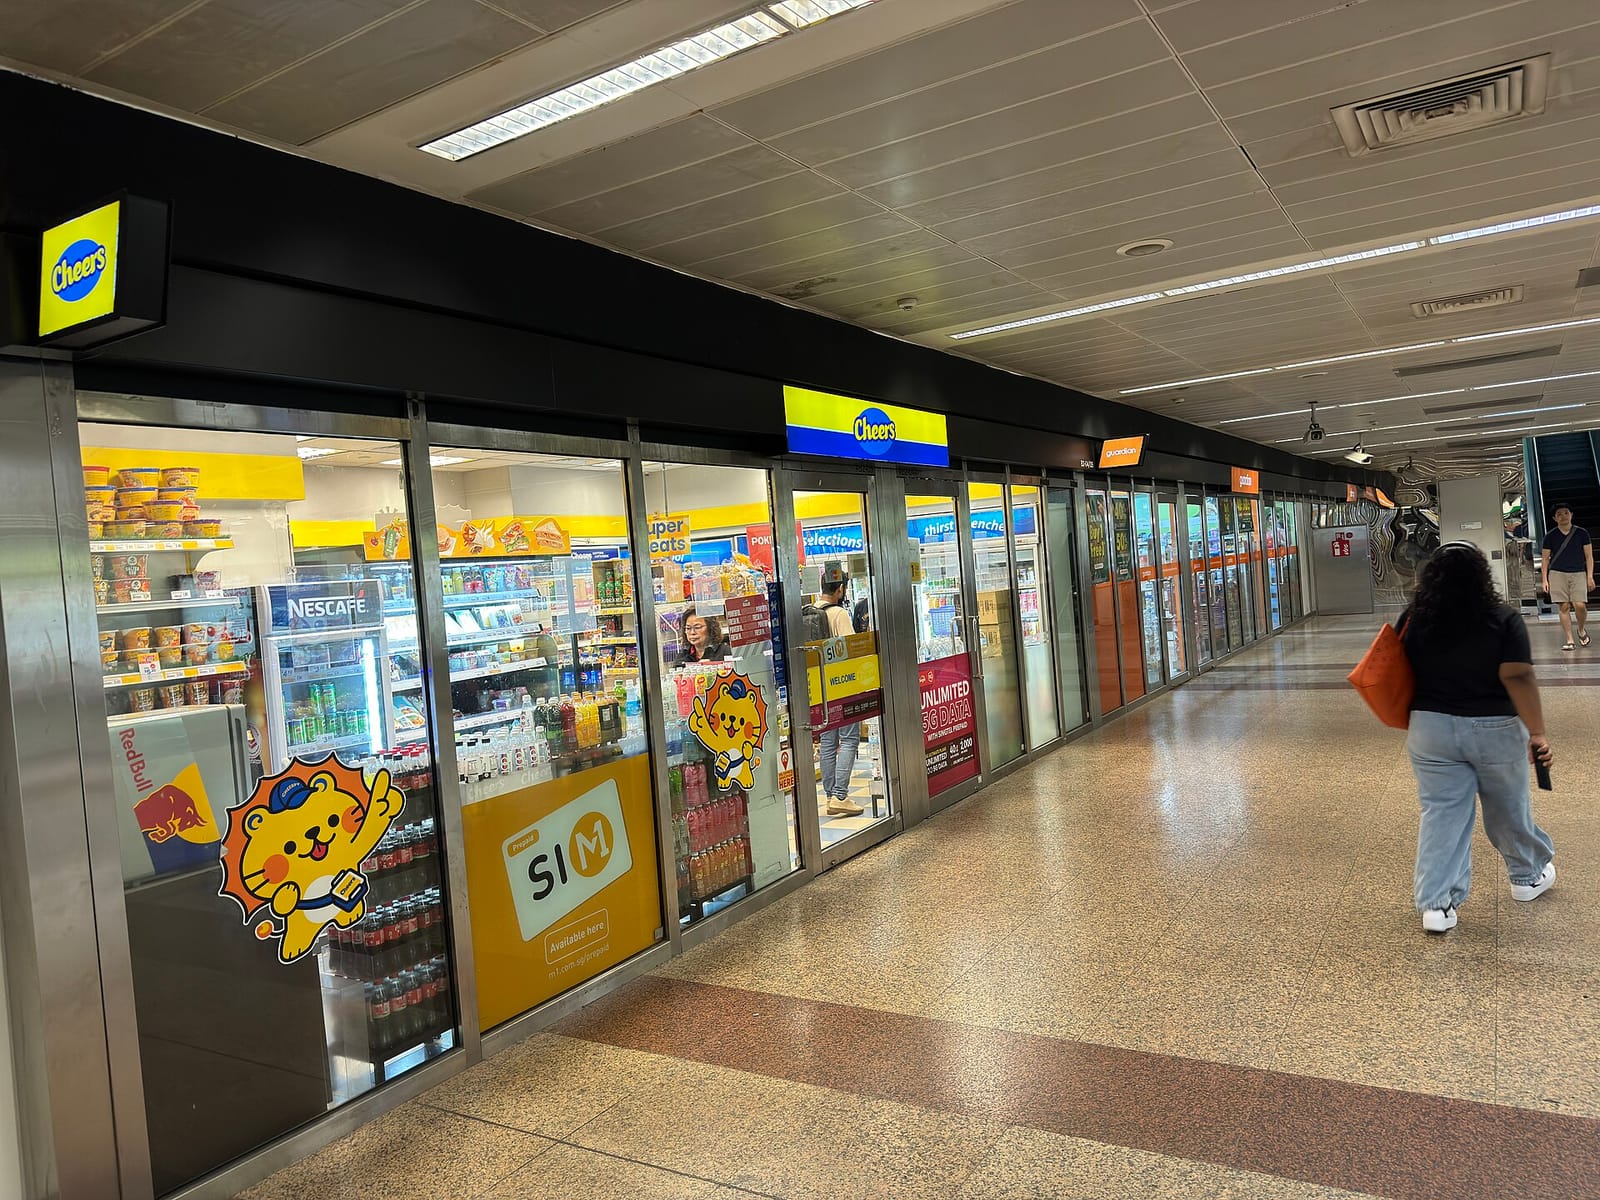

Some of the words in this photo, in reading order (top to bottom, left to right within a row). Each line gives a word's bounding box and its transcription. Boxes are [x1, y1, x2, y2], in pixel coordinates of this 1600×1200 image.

[52, 246, 106, 294] Cheers
[854, 416, 895, 441] Cheers
[1105, 447, 1137, 458] guardian
[925, 520, 954, 537] thirst
[830, 673, 856, 686] WELCOME
[922, 708, 939, 733] 5G
[939, 698, 972, 727] DATA
[779, 777, 794, 790] HERE
[512, 834, 535, 852] Prepaid
[550, 931, 586, 954] Available
[586, 922, 604, 936] here
[548, 943, 610, 979] m1.com.sg/prepaid
